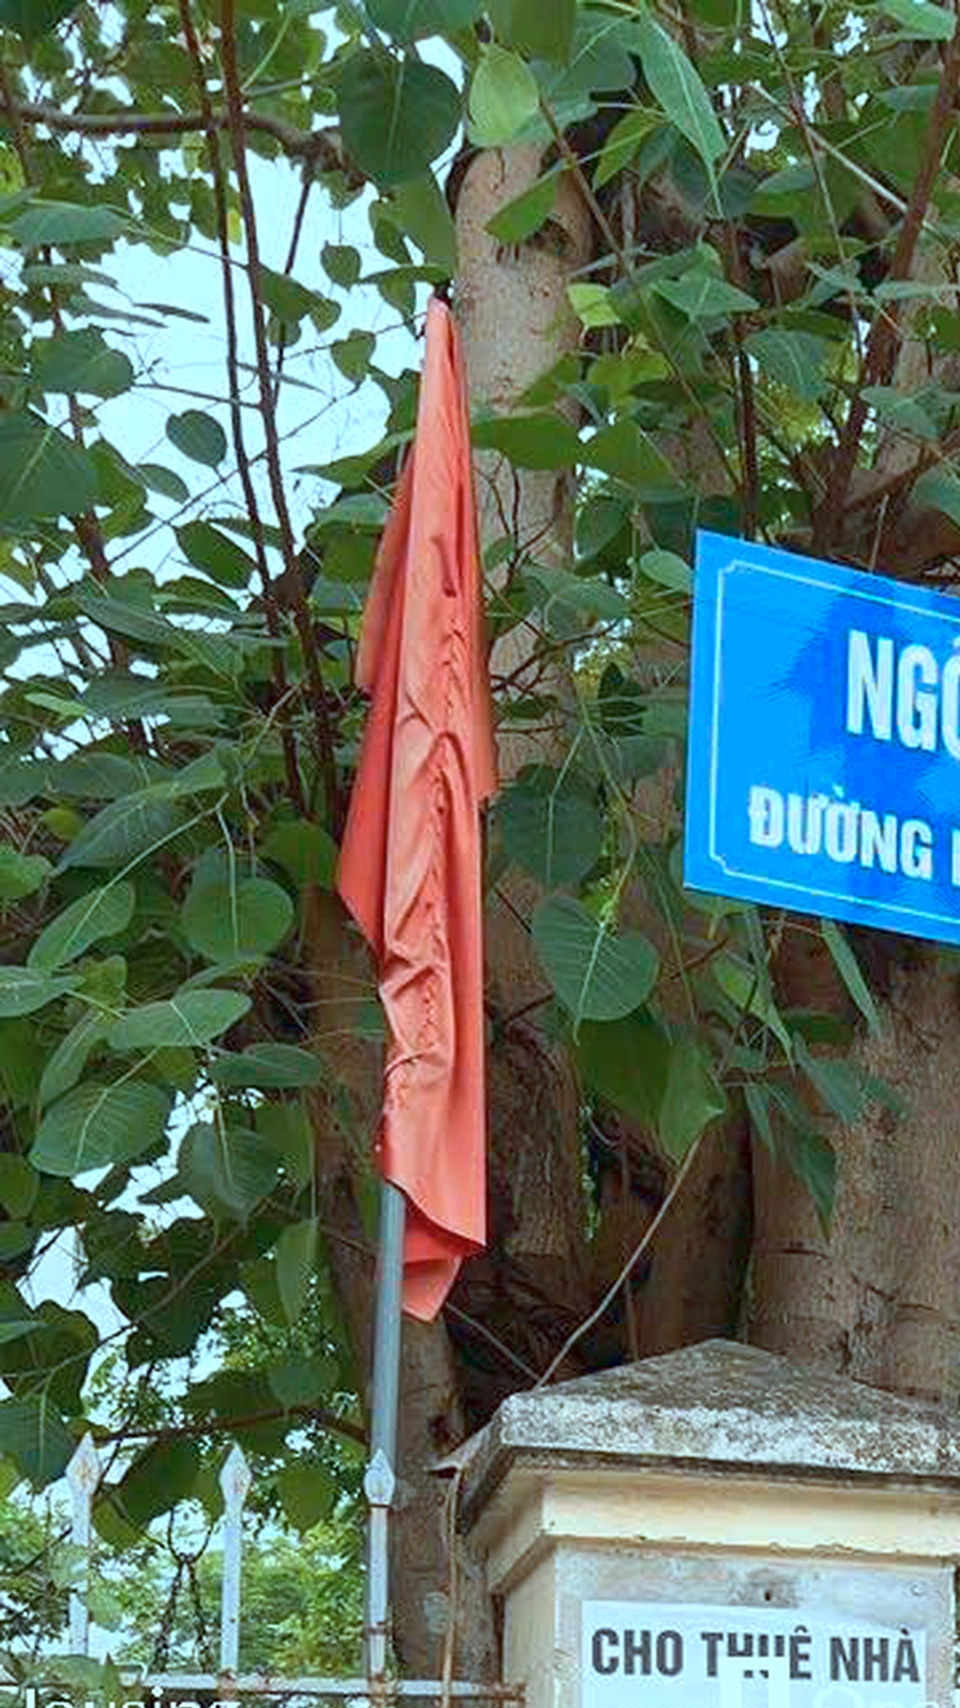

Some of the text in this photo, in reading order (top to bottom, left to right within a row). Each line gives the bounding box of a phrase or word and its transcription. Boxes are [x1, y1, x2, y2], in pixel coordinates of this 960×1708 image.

[748, 783, 934, 881] ĐƯỜNG
[591, 1628, 684, 1677] CHO
[830, 1627, 921, 1683] NHÀ
